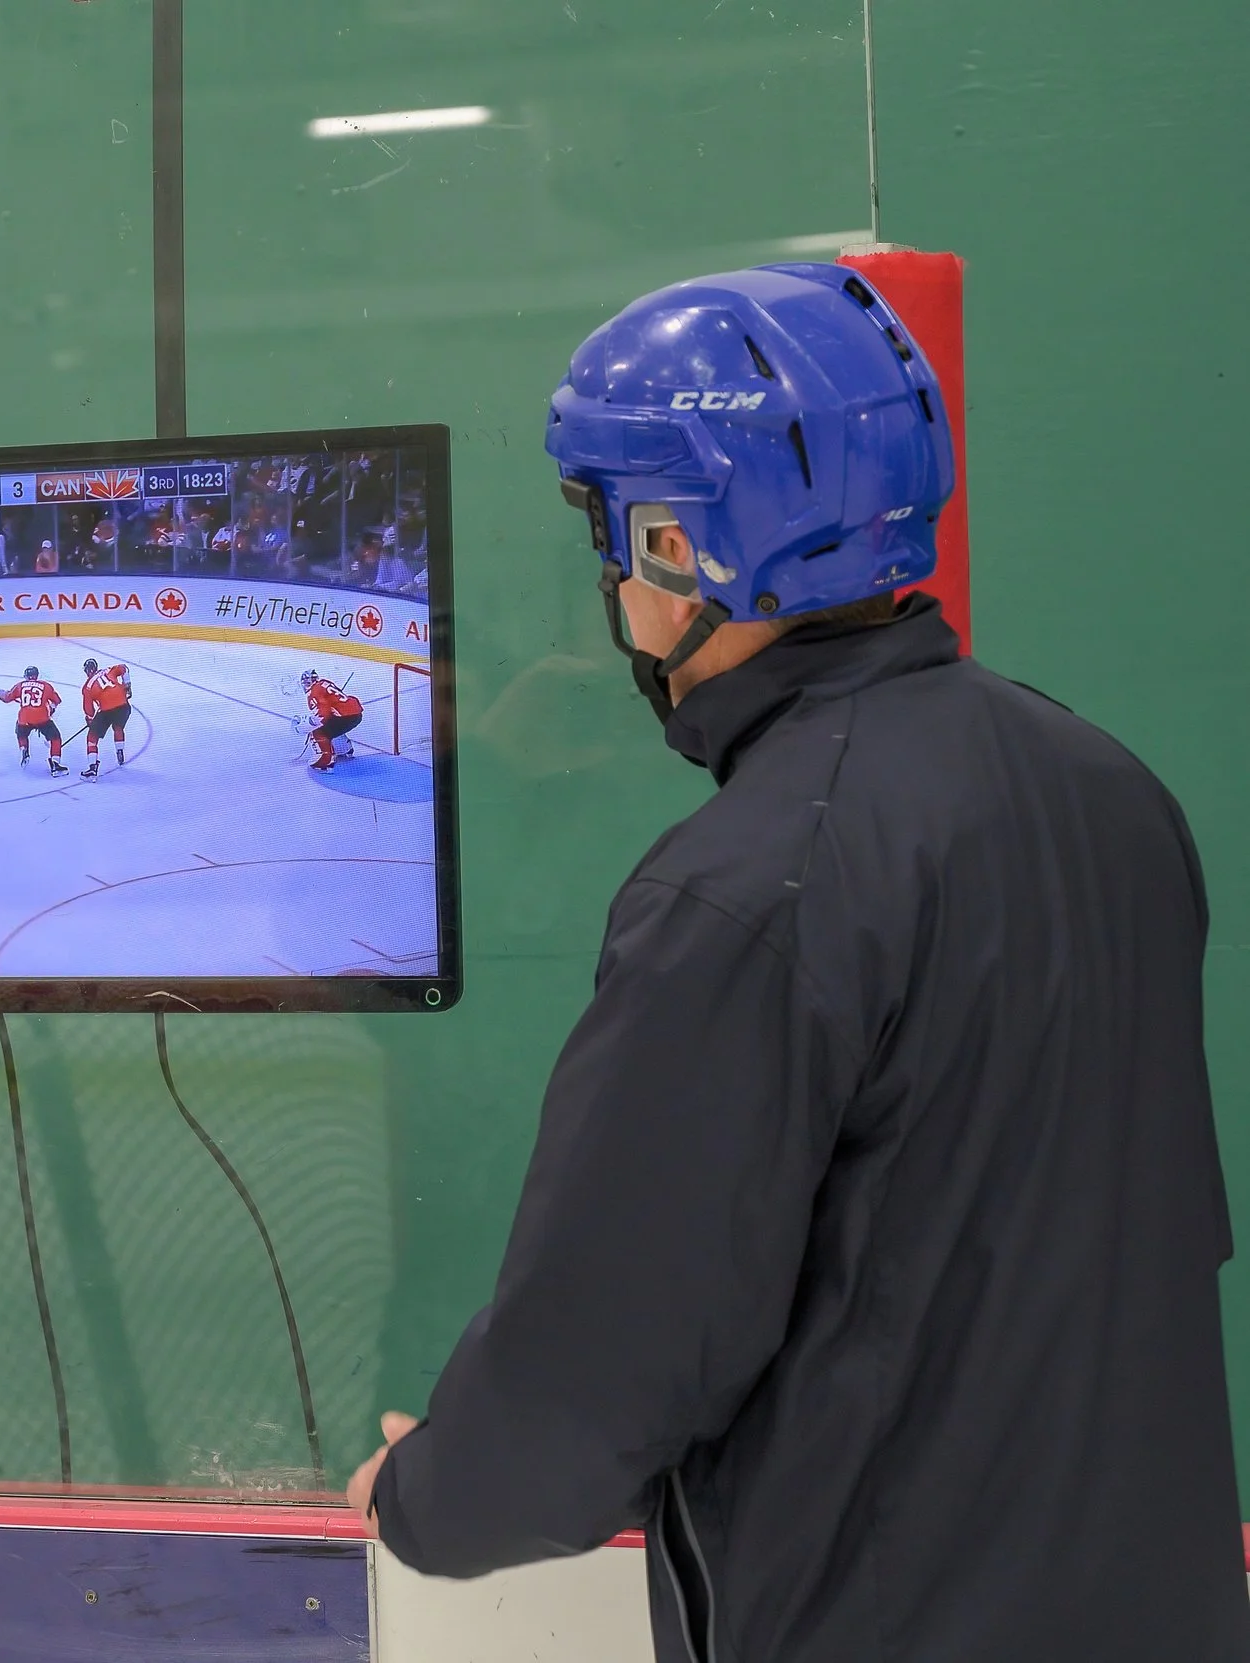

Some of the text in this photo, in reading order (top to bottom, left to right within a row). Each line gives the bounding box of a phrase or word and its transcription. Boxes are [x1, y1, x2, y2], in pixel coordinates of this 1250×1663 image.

[670, 391, 767, 410] CCM
[13, 481, 23, 498] 3
[40, 479, 81, 497] CAN
[149, 475, 175, 490] 3RD
[183, 472, 223, 488] 18:23
[14, 592, 143, 611] CANADA
[215, 594, 354, 637] #FlyTheFlag
[21, 687, 43, 707] 63
